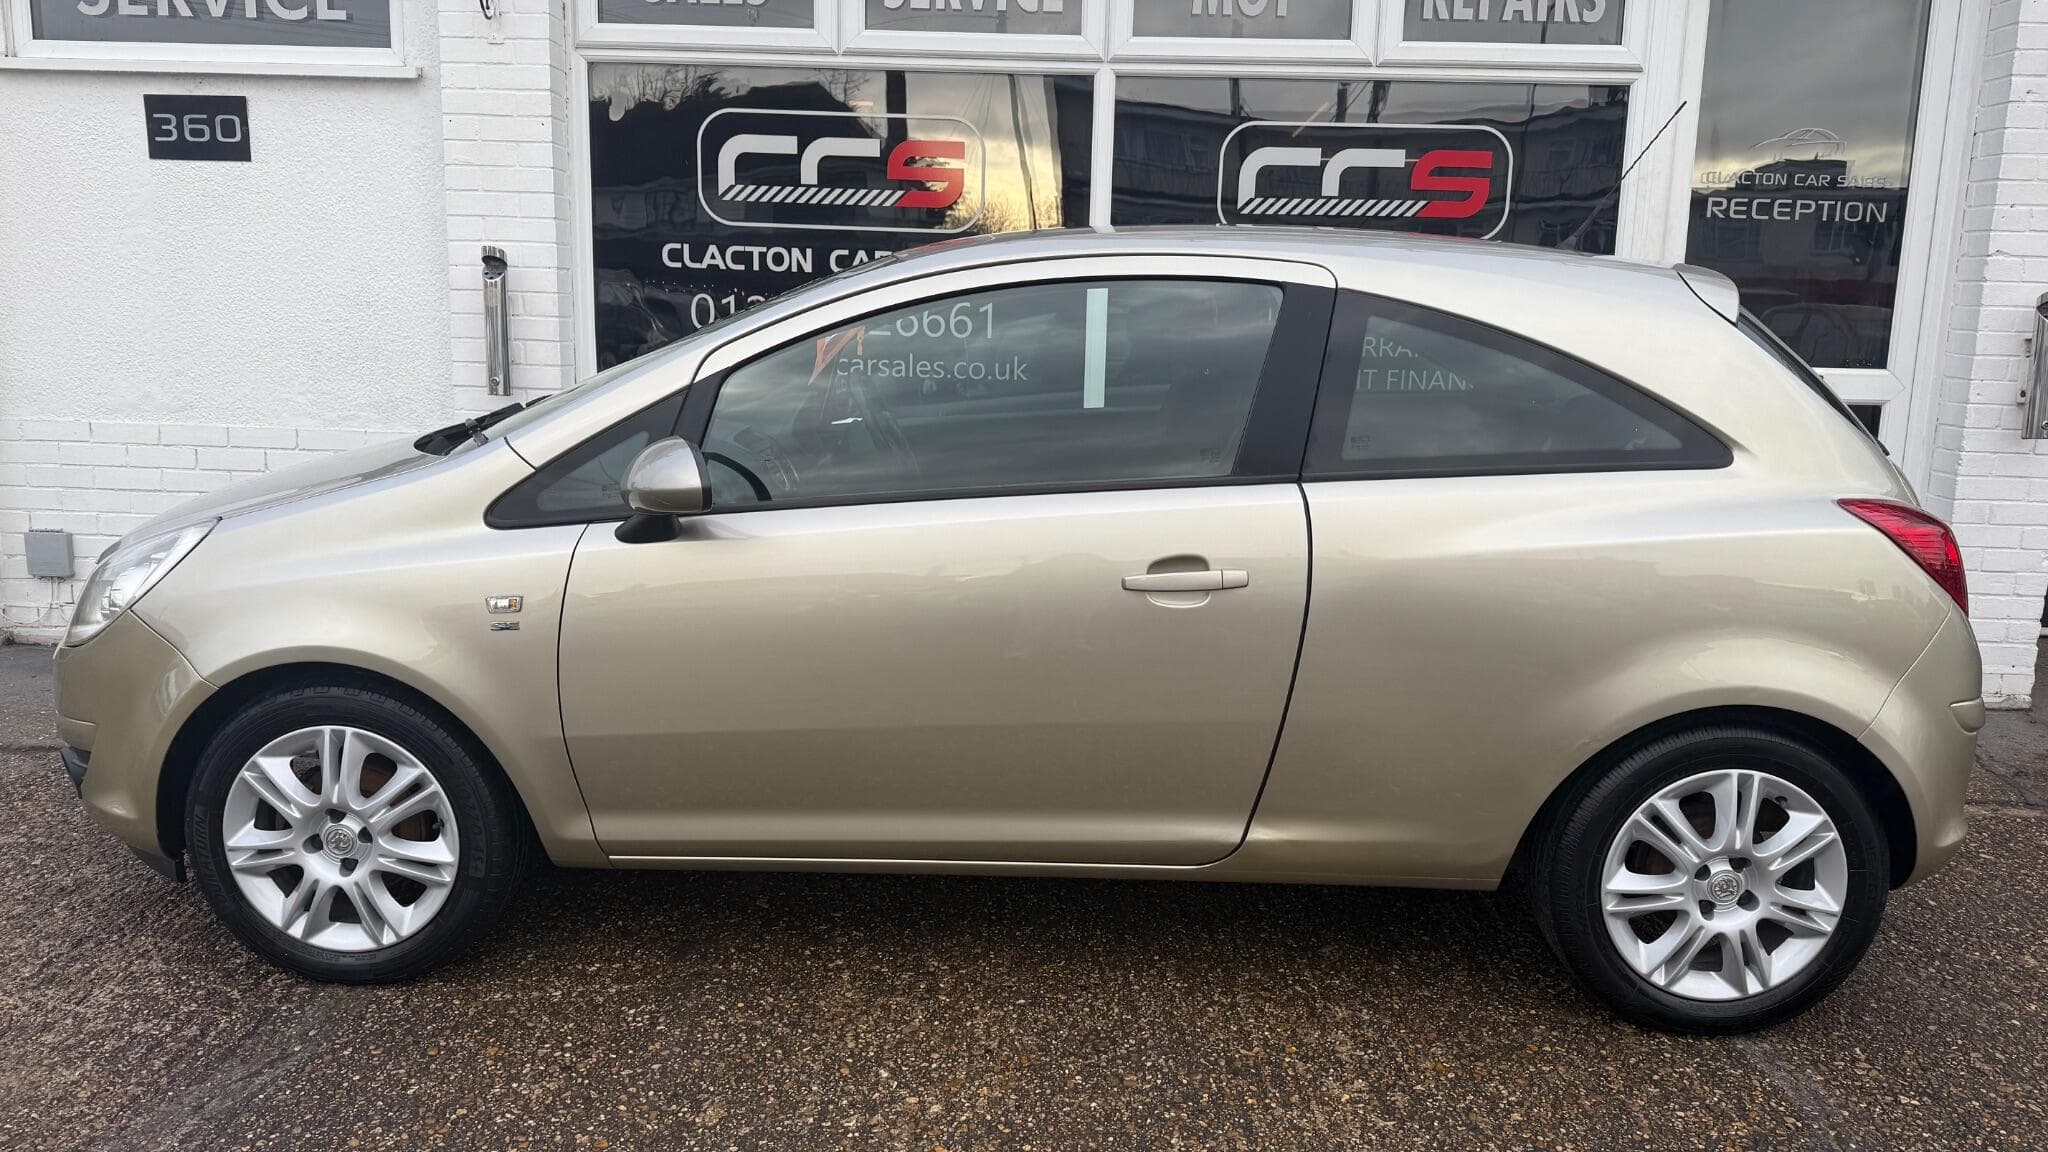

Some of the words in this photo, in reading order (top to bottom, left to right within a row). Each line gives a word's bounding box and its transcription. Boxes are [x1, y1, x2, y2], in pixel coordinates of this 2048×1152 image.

[152, 113, 242, 142] 360
[1793, 174, 1830, 187] CAR
[1706, 197, 1888, 223] RECEPTION
[662, 242, 813, 273] CLACTON
